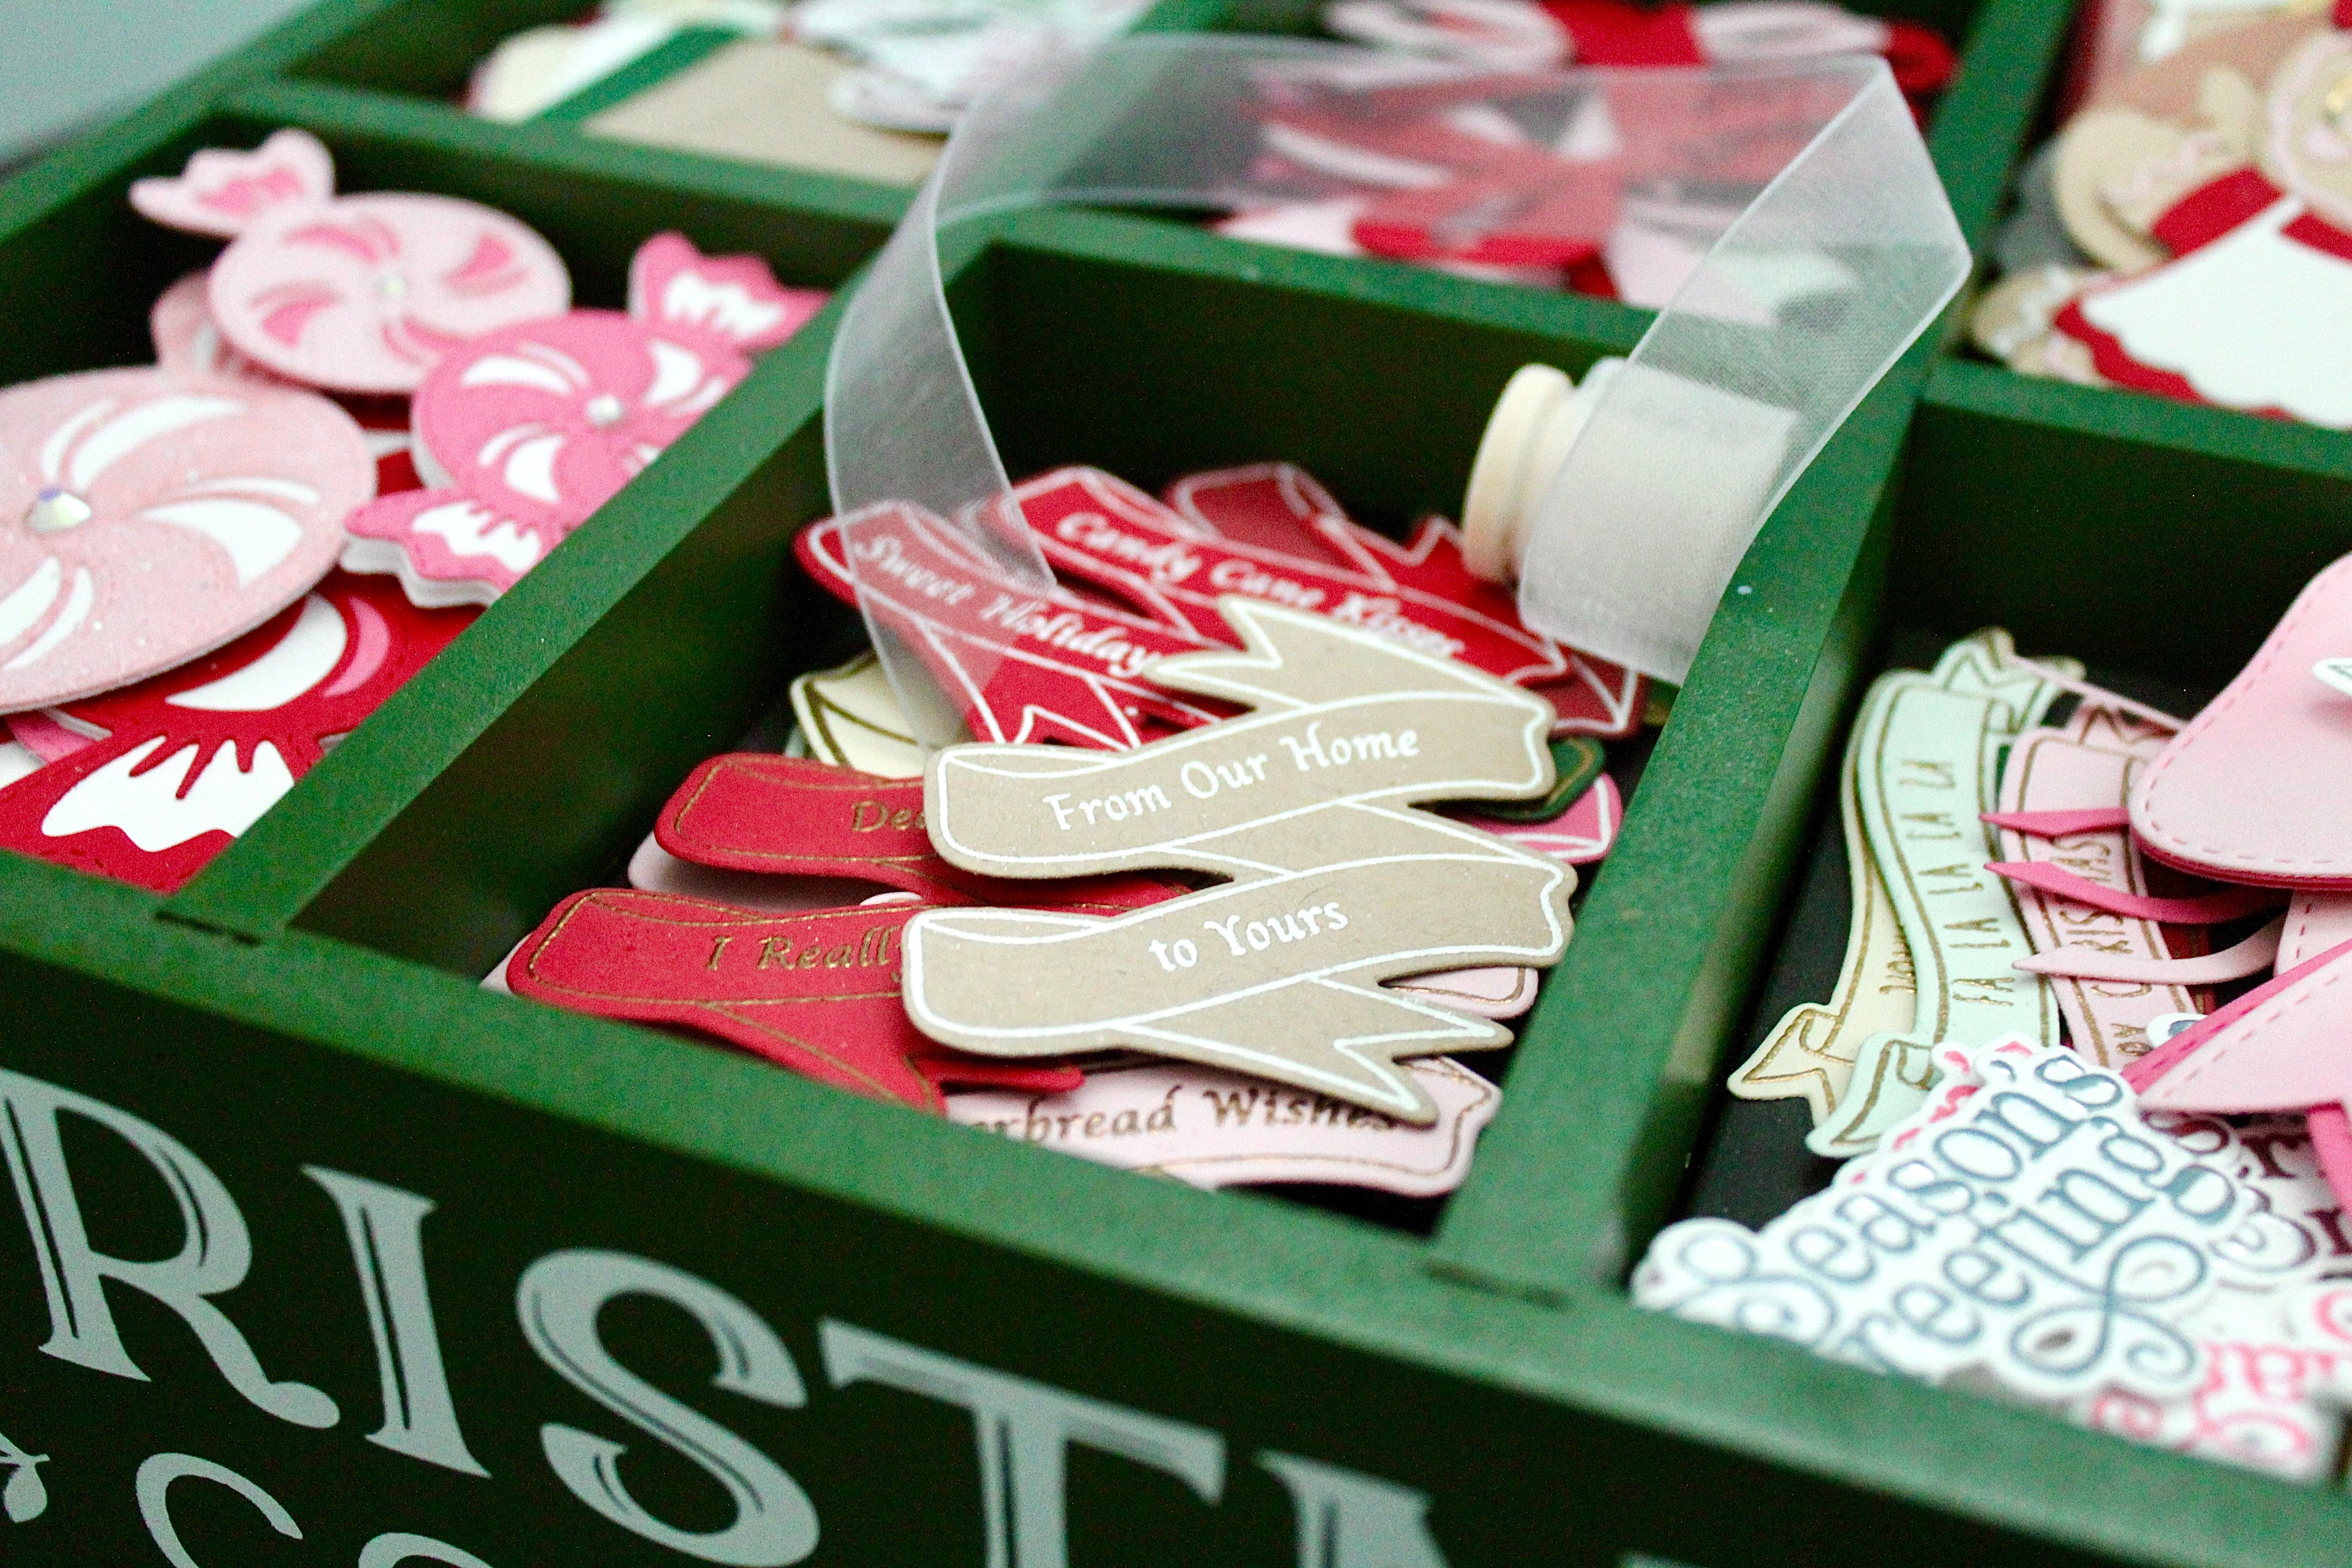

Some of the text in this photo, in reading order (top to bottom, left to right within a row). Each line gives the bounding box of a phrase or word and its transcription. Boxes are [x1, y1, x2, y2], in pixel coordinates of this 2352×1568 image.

[856, 534, 975, 605] Sweet
[1057, 512, 1202, 584] Candy
[1210, 557, 1327, 609] Cane
[1042, 721, 1420, 831] From Our Home
[1899, 811, 1962, 840] LA
[1917, 864, 1985, 895] LA
[706, 924, 902, 982] I Reall
[1148, 900, 1350, 973] to Yours
[1943, 917, 2010, 949] LA
